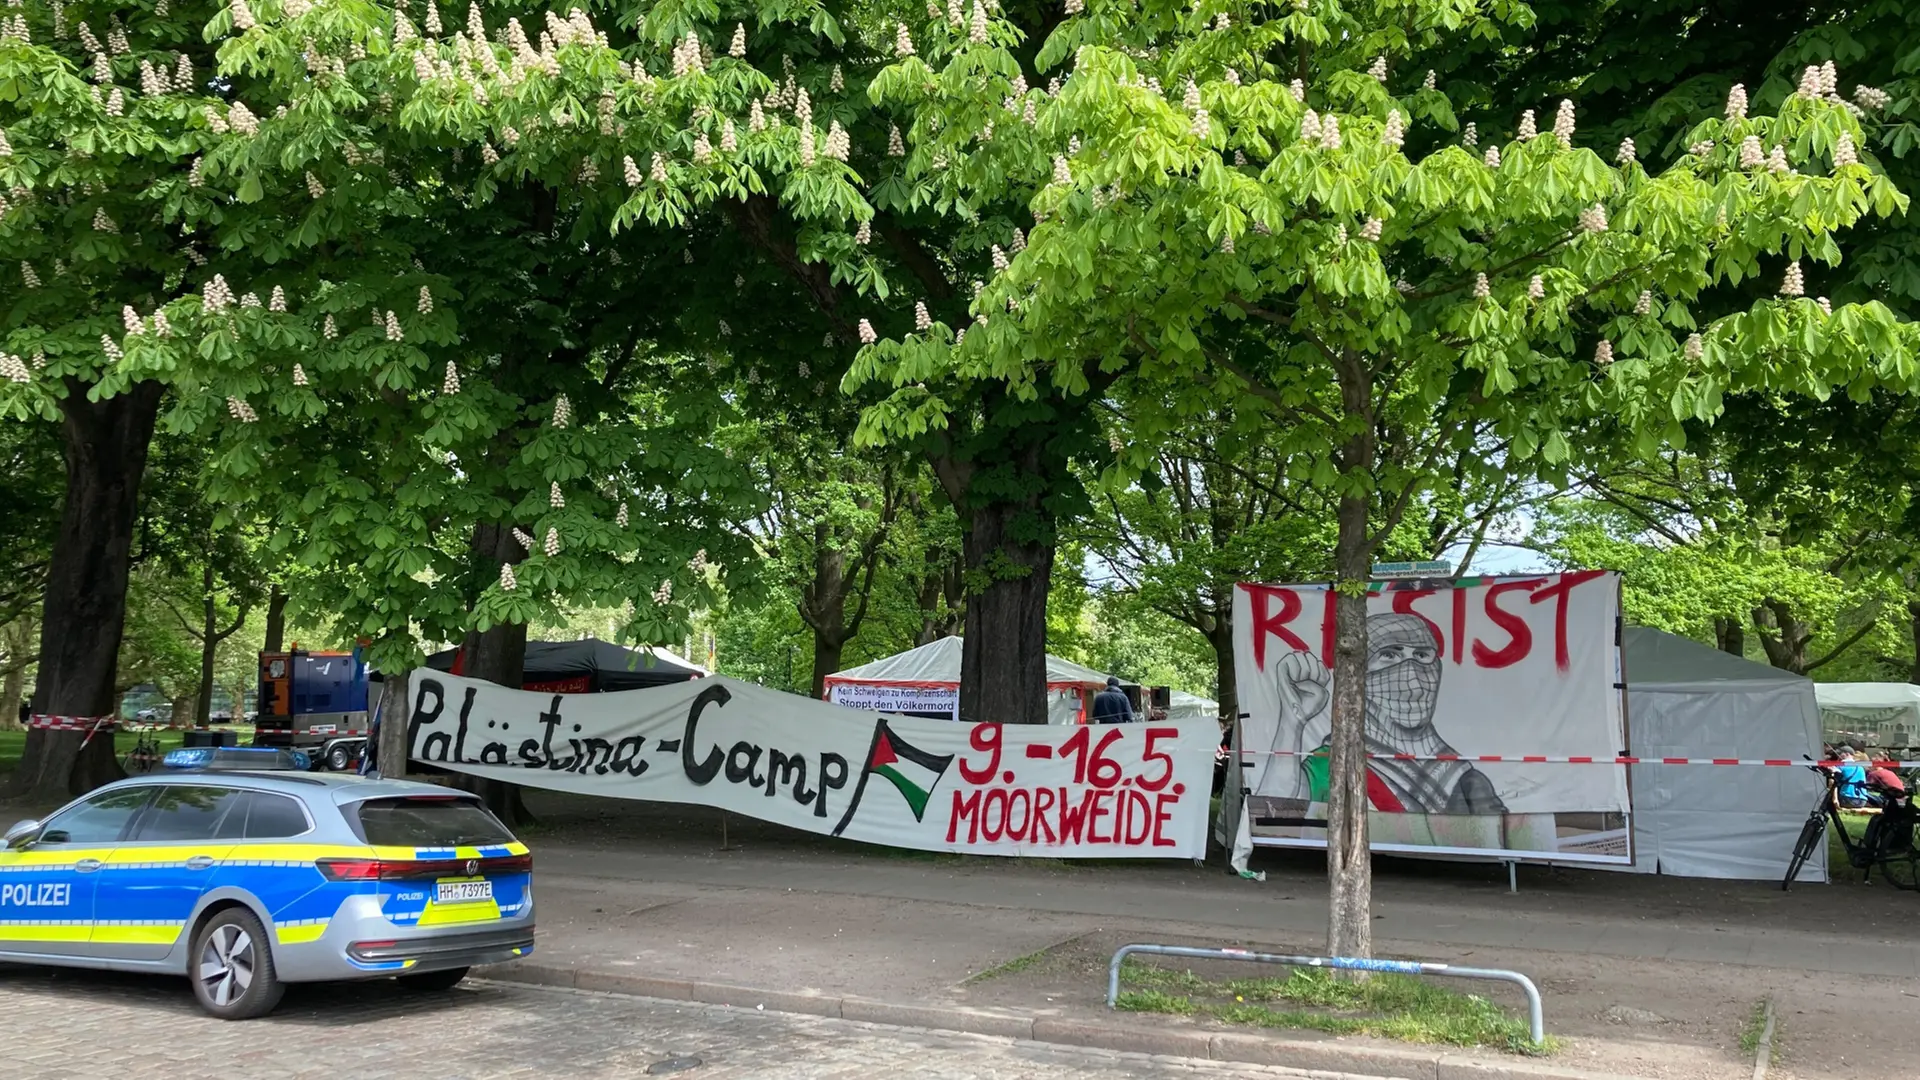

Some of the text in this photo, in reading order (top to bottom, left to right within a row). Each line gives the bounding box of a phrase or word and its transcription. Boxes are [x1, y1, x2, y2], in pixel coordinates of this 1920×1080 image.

[838, 687, 853, 696] Kein
[854, 687, 891, 698] Schweigen
[891, 689, 900, 697] zu
[840, 698, 954, 710] Stoppt den Völkermord
[407, 679, 849, 818] Palästina-Camp
[945, 787, 1180, 847] MOORWEIDE
[1, 883, 71, 906] POLIZEI
[397, 892, 423, 901] POLIZEI
[440, 883, 490, 899] HH 7397E
